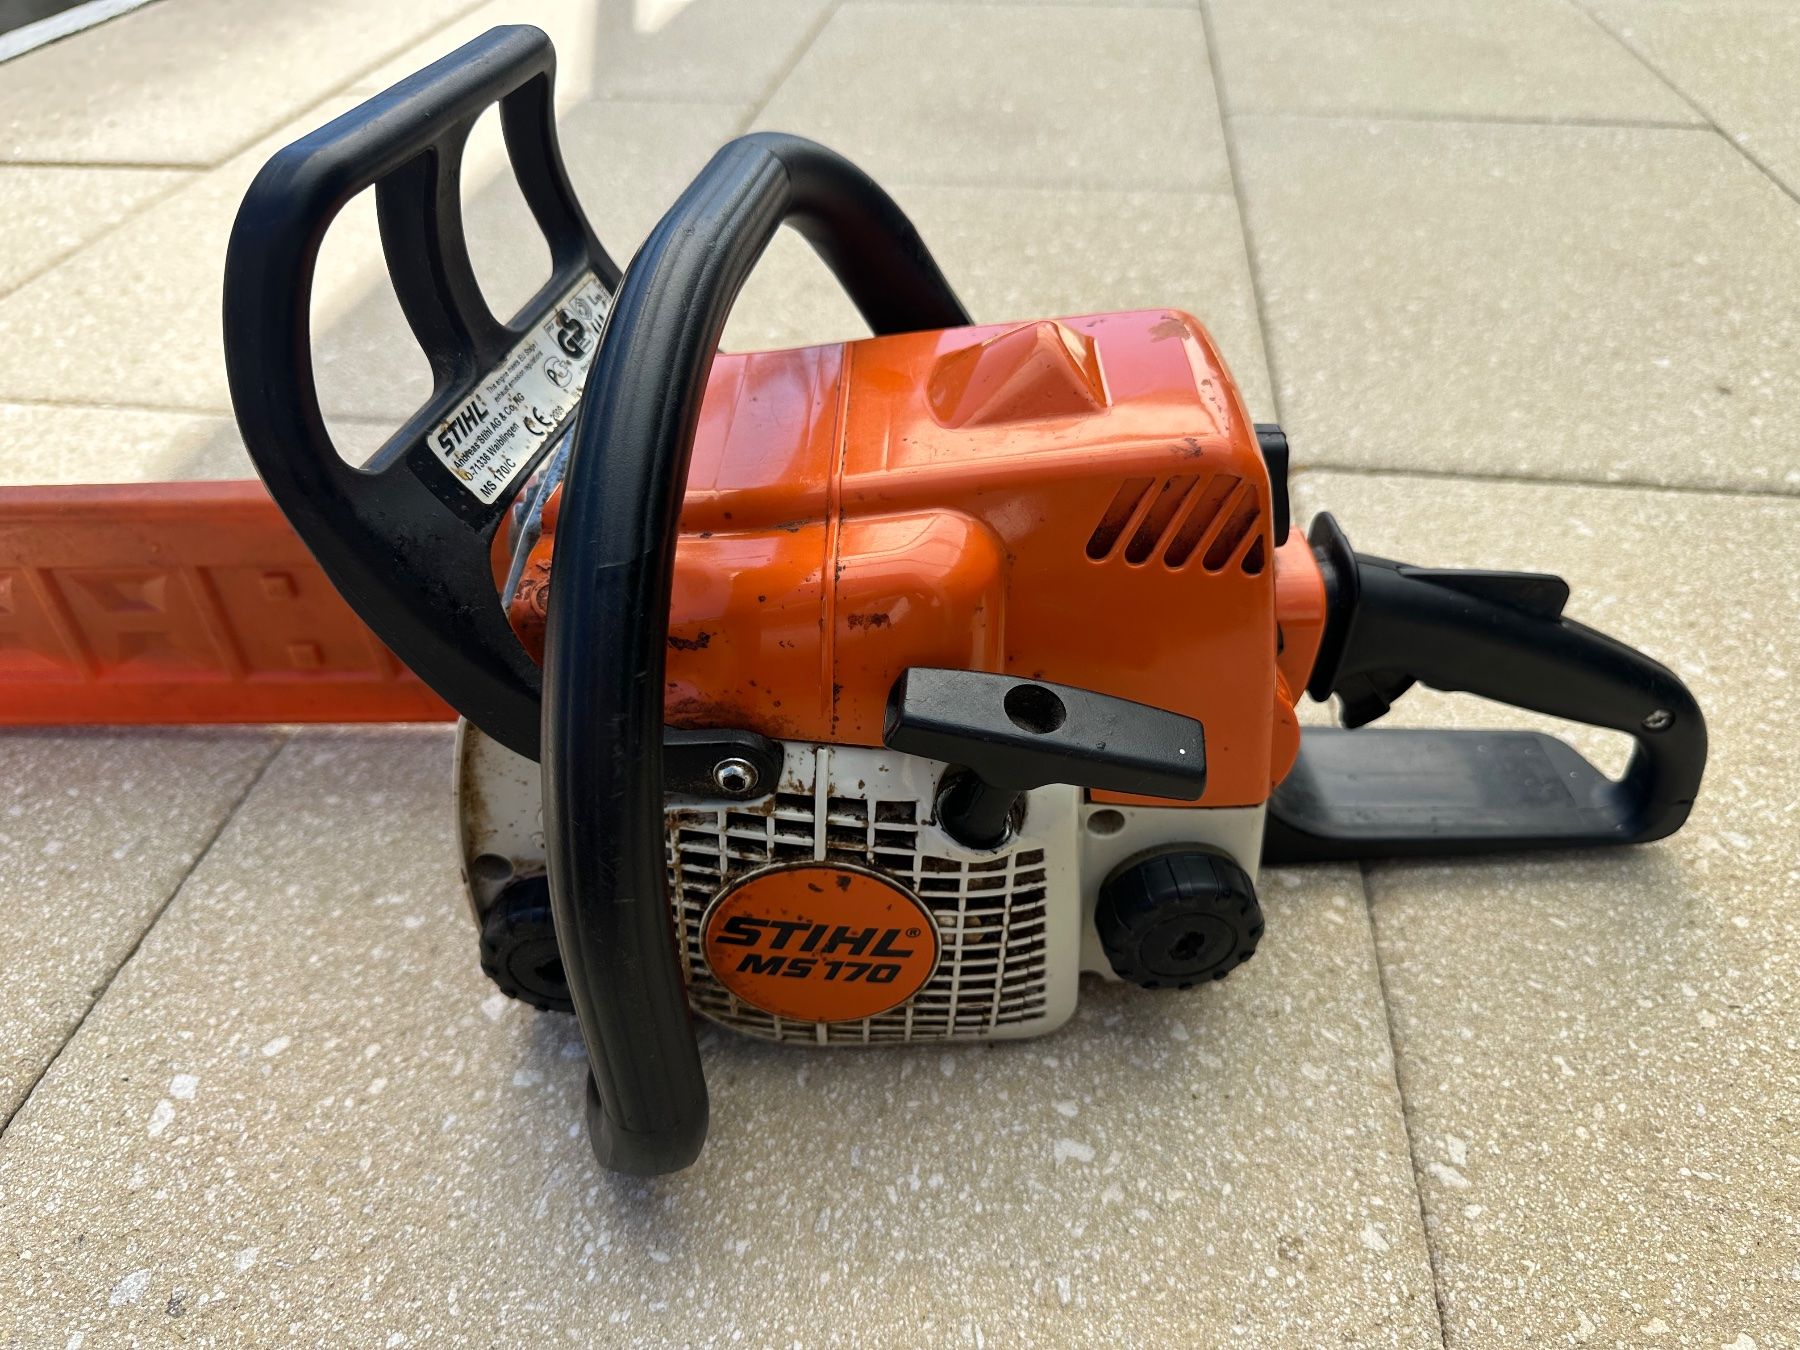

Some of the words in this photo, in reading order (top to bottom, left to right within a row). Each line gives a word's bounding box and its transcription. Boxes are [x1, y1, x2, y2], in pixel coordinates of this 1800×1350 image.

[454, 441, 480, 467] Andreas
[476, 425, 493, 445] Stihl
[489, 416, 502, 430] AG
[464, 451, 491, 480] D-71336
[486, 421, 519, 456] Waiblingen
[479, 479, 497, 498] MS
[492, 457, 516, 483] 170/C
[736, 954, 818, 978] MS
[824, 962, 902, 984] 170
